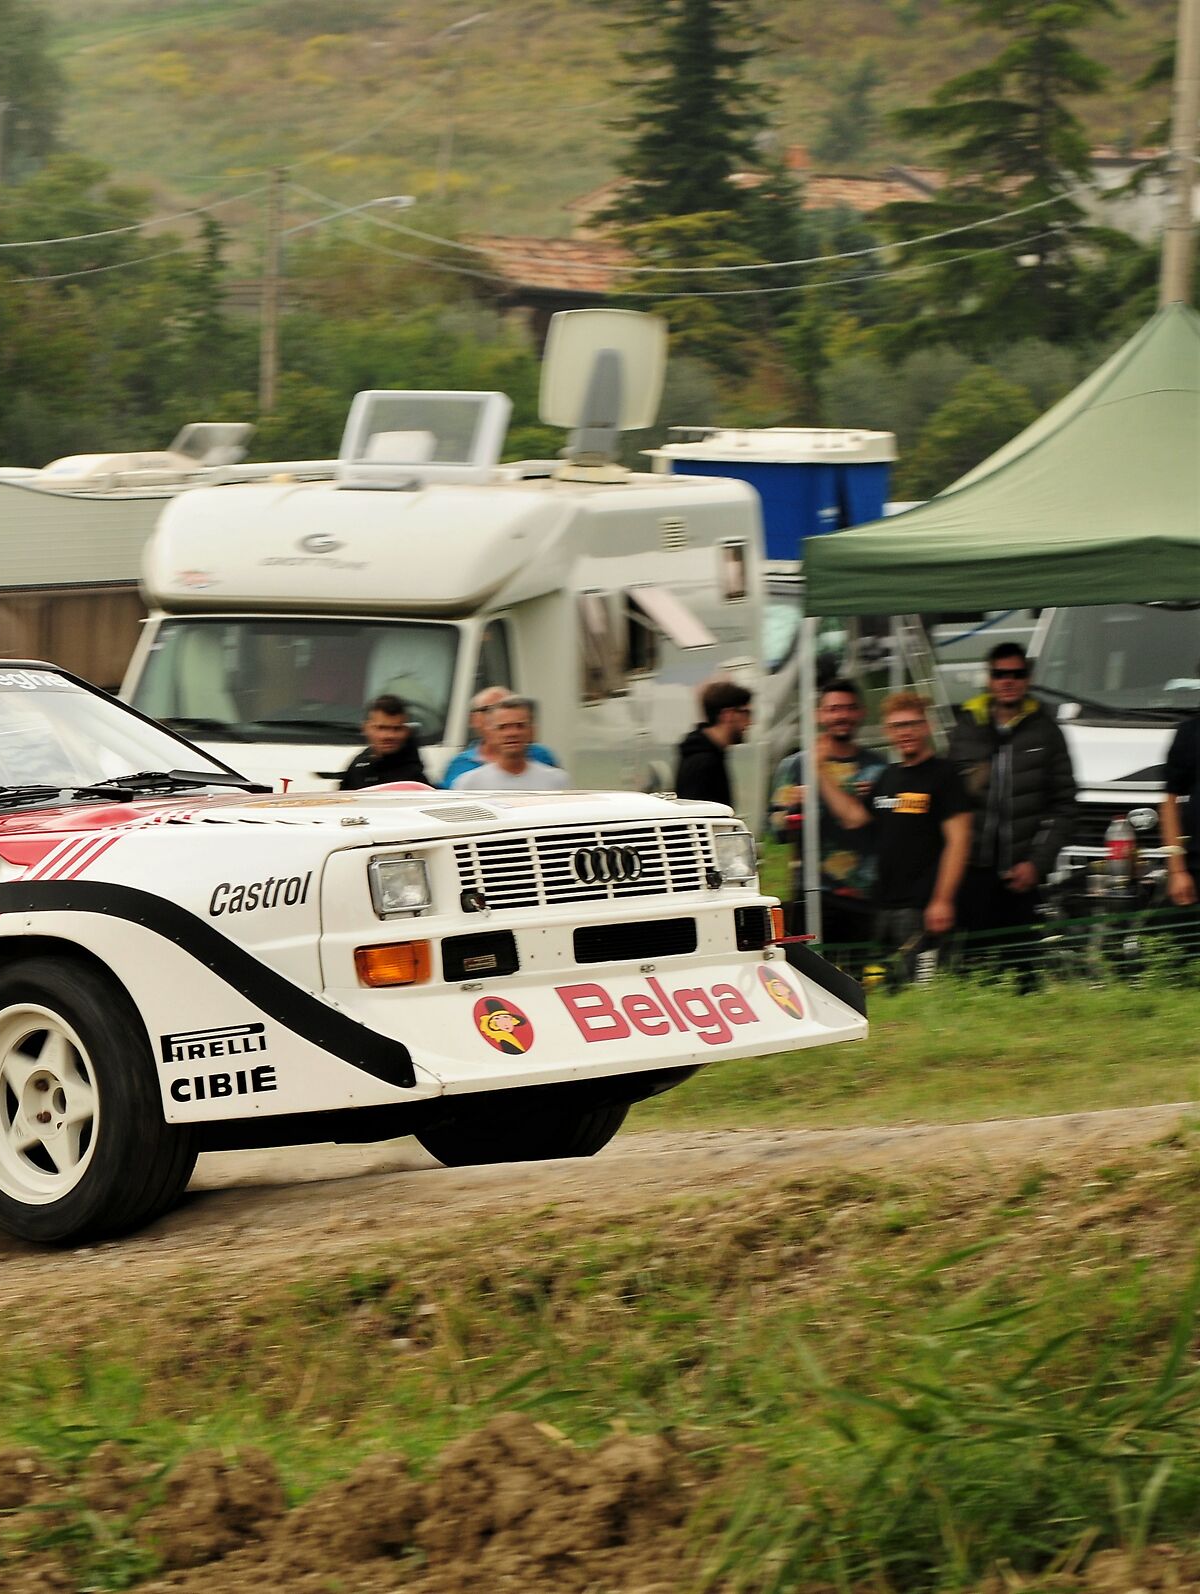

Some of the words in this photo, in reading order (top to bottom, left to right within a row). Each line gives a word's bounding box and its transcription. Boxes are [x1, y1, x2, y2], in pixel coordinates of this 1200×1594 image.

[209, 870, 313, 917] Castrol
[553, 976, 760, 1046] Belga
[160, 1022, 267, 1063] PIRELLI
